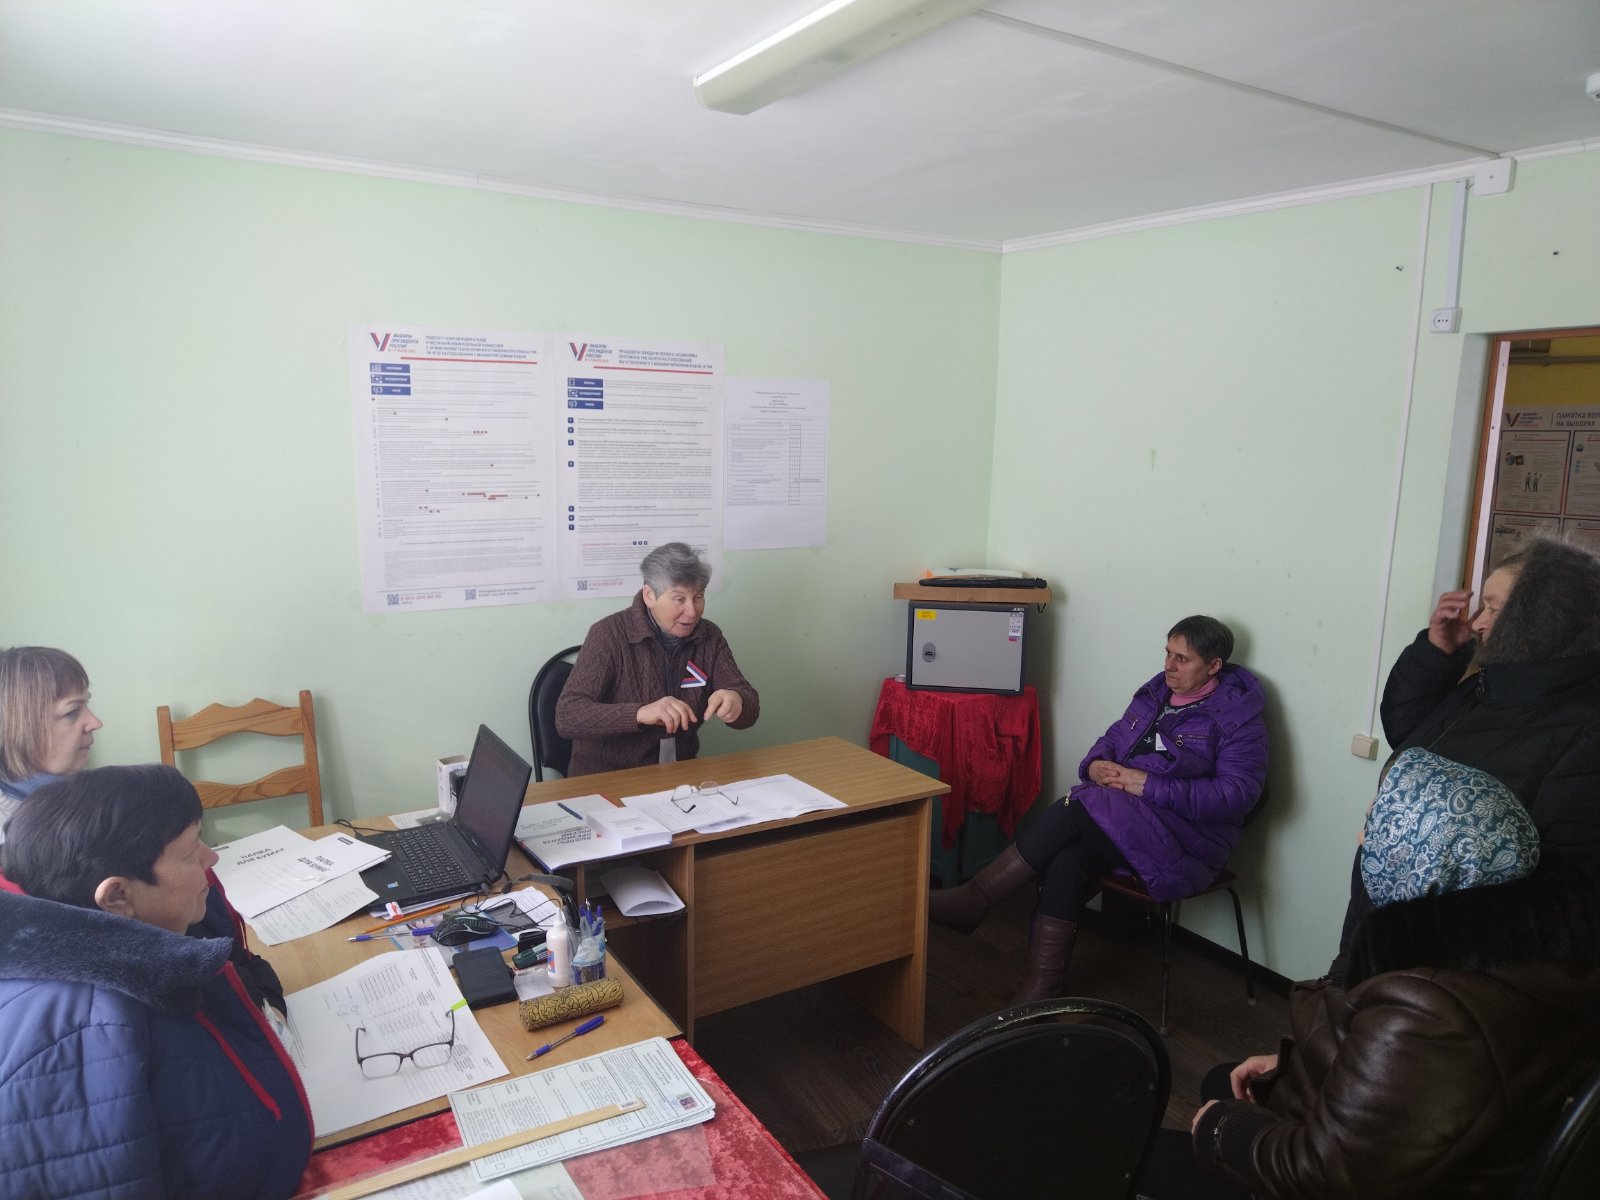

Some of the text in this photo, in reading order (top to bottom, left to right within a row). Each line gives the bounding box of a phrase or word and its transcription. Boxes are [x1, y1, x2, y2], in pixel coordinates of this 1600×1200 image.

[542, 832, 592, 844] ПРЕЗИДЕНТА
[557, 837, 592, 845] ВЫБОРЫ
[241, 848, 271, 859] ПАПКА
[237, 857, 255, 866] ДЛЯ
